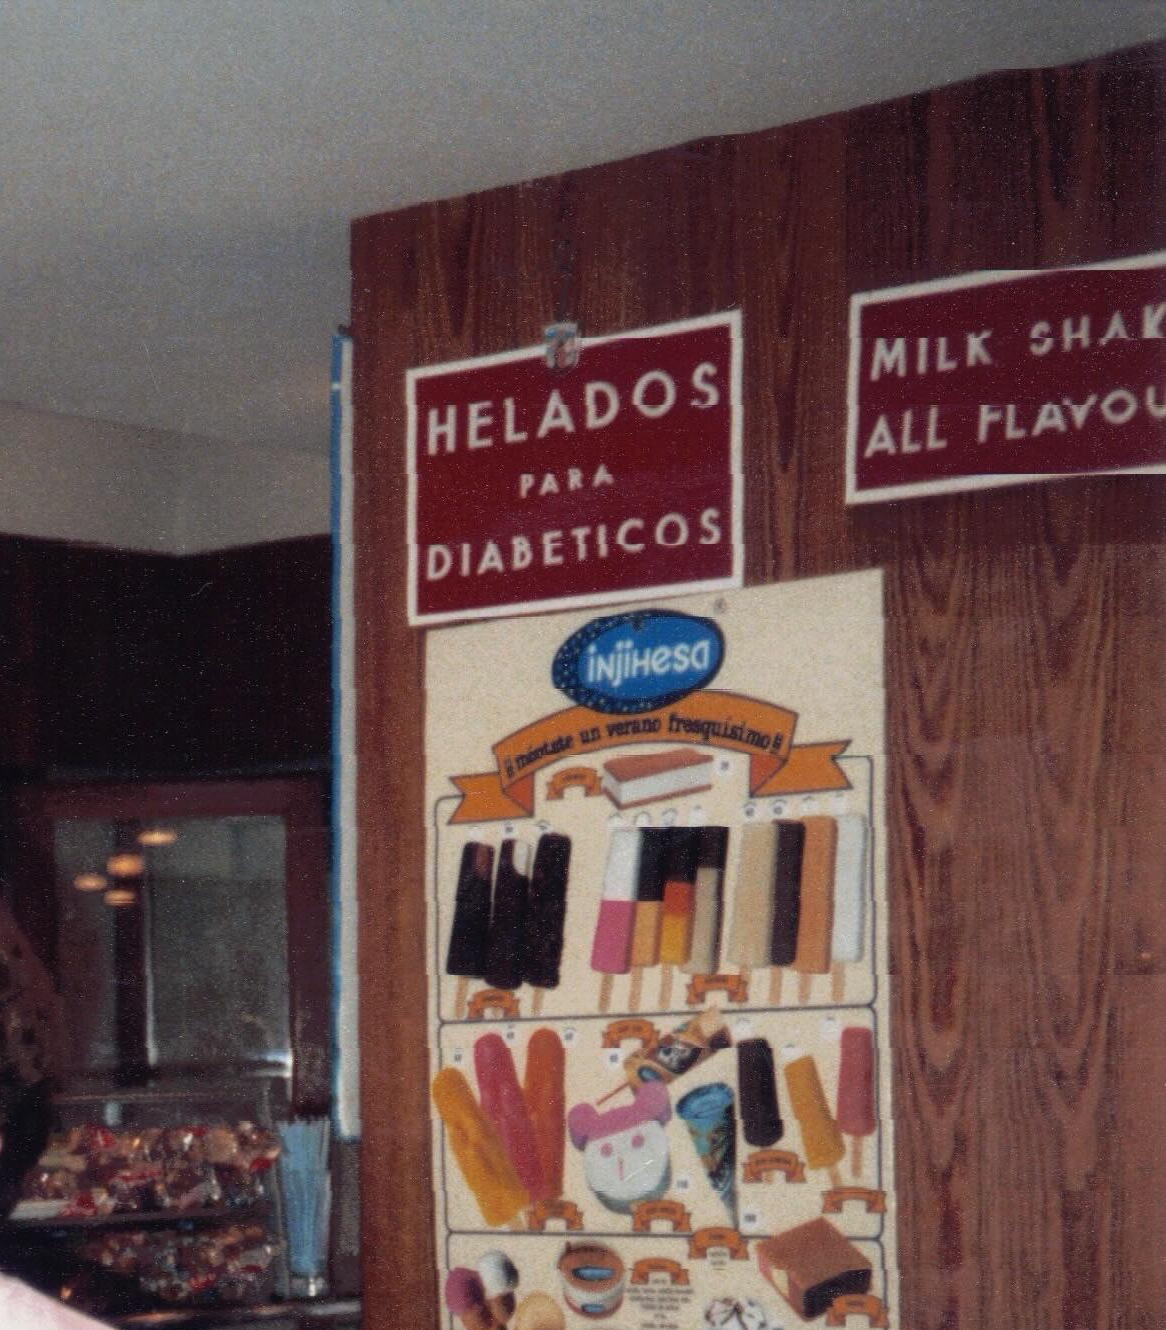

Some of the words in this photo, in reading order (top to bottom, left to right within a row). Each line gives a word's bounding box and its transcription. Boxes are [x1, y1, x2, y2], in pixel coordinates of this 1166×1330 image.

[870, 329, 994, 381] MILK
[426, 361, 720, 456] HELADOS
[863, 407, 948, 459] ALL
[519, 463, 614, 499] PARA
[426, 507, 722, 581] DIABETICOS
[606, 717, 662, 738] verano
